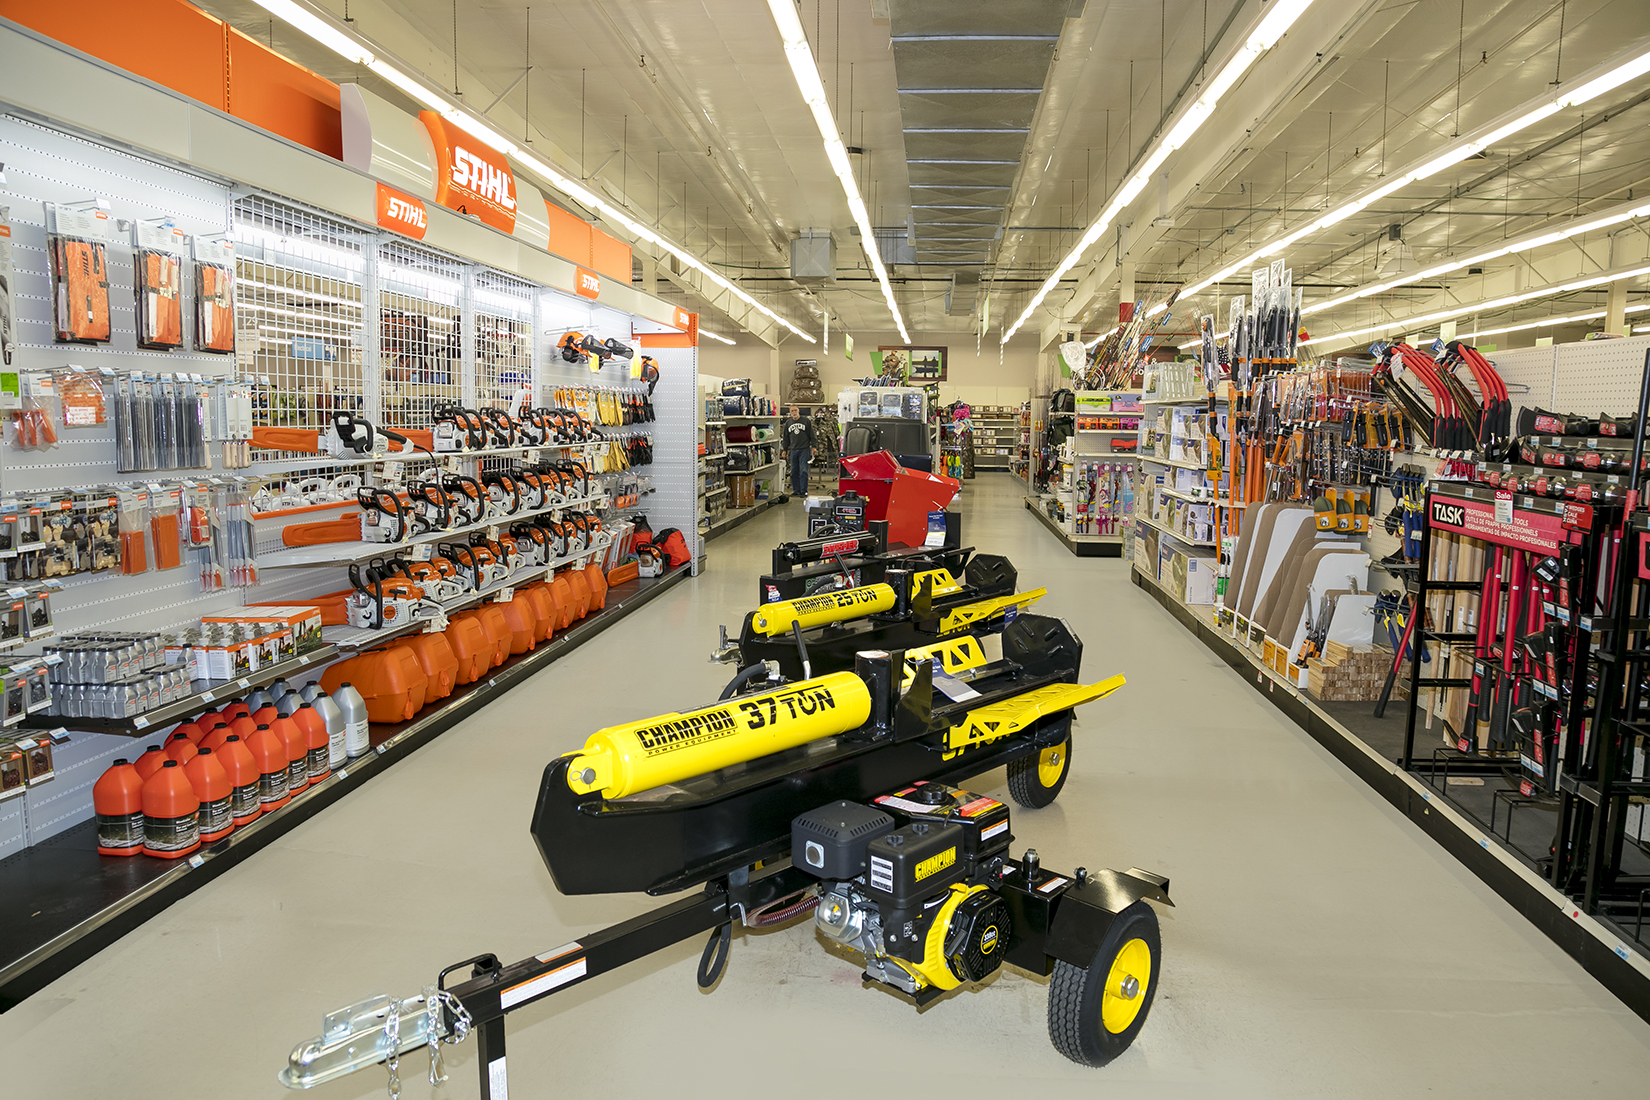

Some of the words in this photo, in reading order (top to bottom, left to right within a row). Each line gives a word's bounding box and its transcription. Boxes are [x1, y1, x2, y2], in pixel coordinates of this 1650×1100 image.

[452, 145, 515, 210] STIHL
[387, 196, 427, 229] STIHL
[81, 250, 90, 279] STIHL
[581, 274, 600, 293] STIHL
[1496, 491, 1511, 500] Sale
[1434, 503, 1463, 526] TASK
[1466, 508, 1494, 519] PROFESSIONAL
[1514, 517, 1529, 527] TOOLS
[1568, 504, 1586, 513] WEDGES
[823, 540, 858, 554] SWISHER
[1501, 531, 1520, 541] IMPACTO
[1520, 535, 1557, 550] PROFESIONALES
[792, 595, 835, 612] CHAMPION
[833, 591, 853, 608] 25
[851, 588, 878, 604] TON
[637, 709, 736, 749] CHAMPION
[738, 697, 777, 730] 37
[779, 687, 836, 720] TON
[648, 744, 681, 756] POWER
[685, 729, 737, 746] EQUIPMENT
[915, 846, 957, 878] CHAMPION
